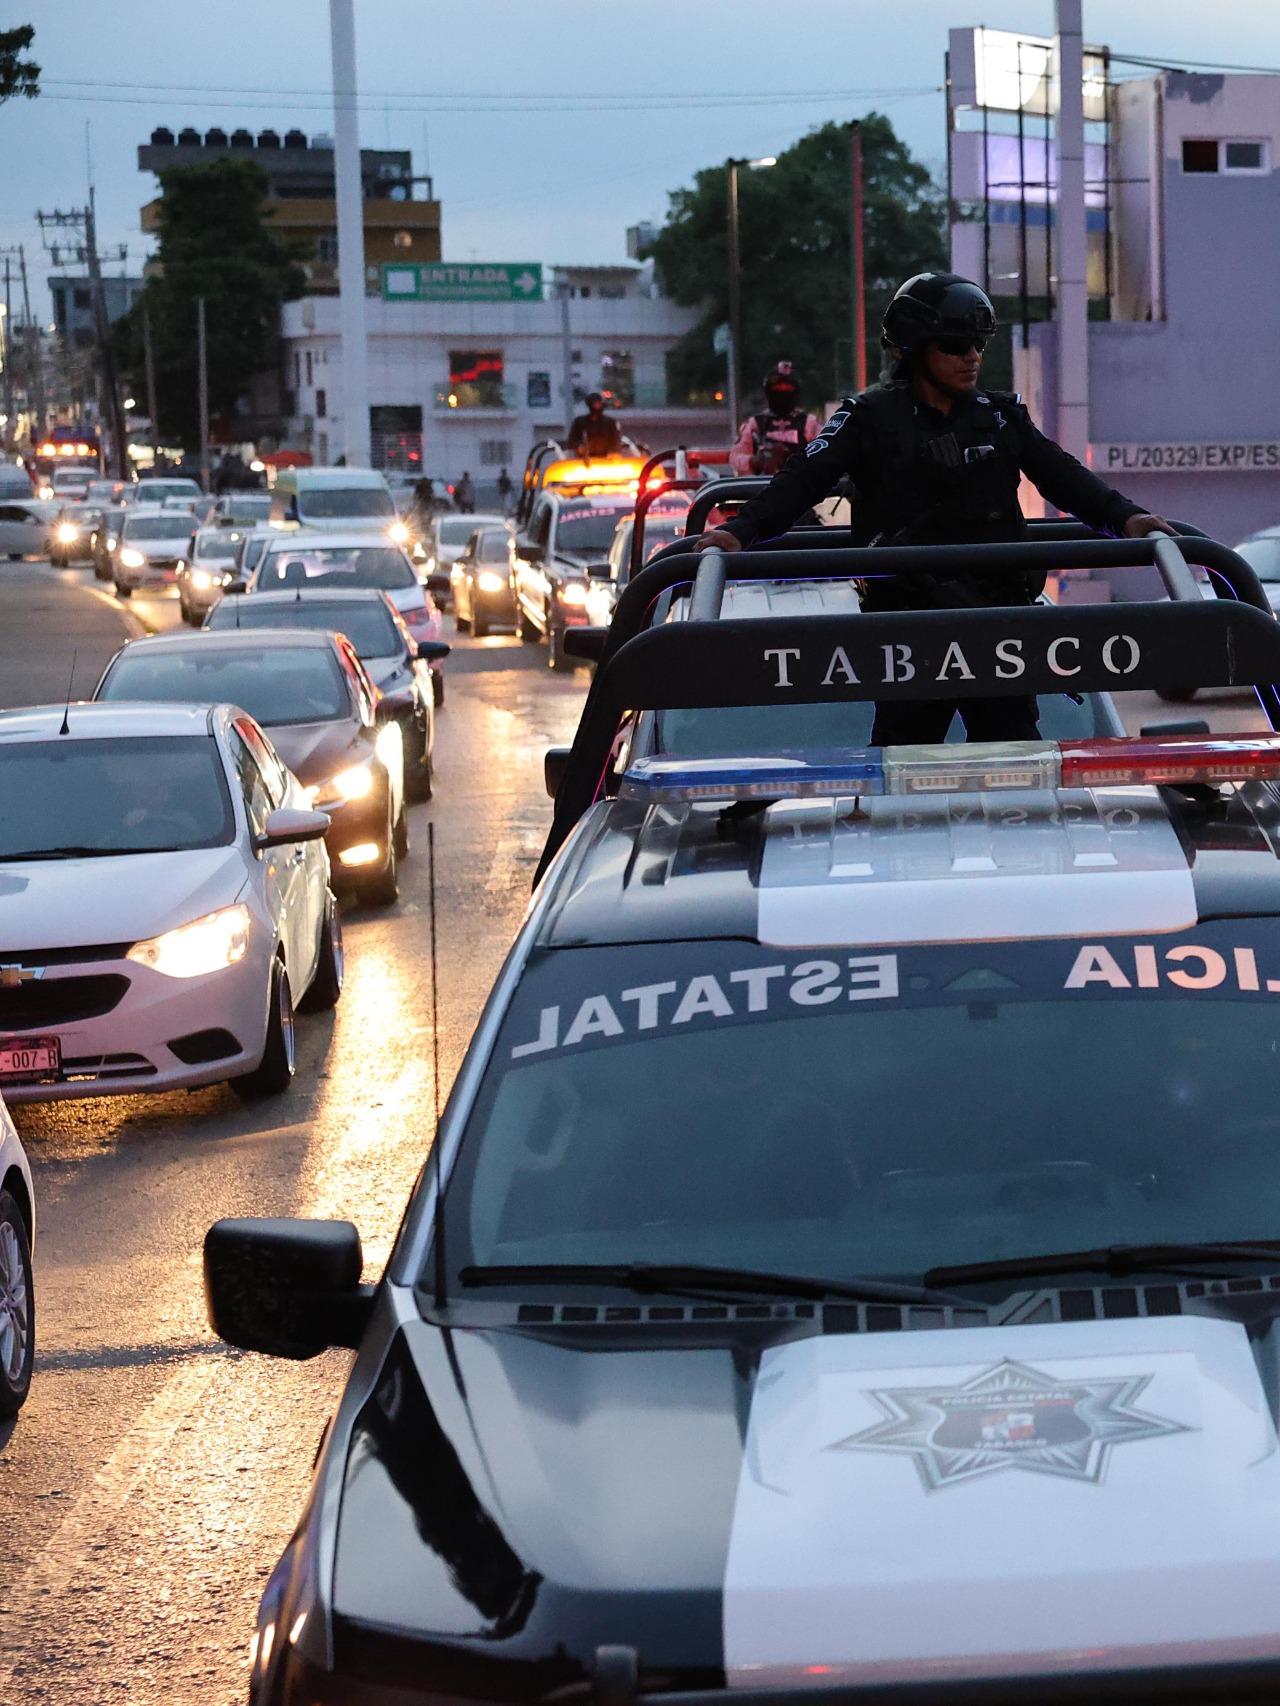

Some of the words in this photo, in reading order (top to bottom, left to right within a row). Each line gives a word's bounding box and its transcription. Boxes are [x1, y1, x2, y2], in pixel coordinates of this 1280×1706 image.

[421, 268, 508, 282] ENTRADA
[764, 634, 1141, 687] TABASCO
[0, 1051, 57, 1070] -007-B
